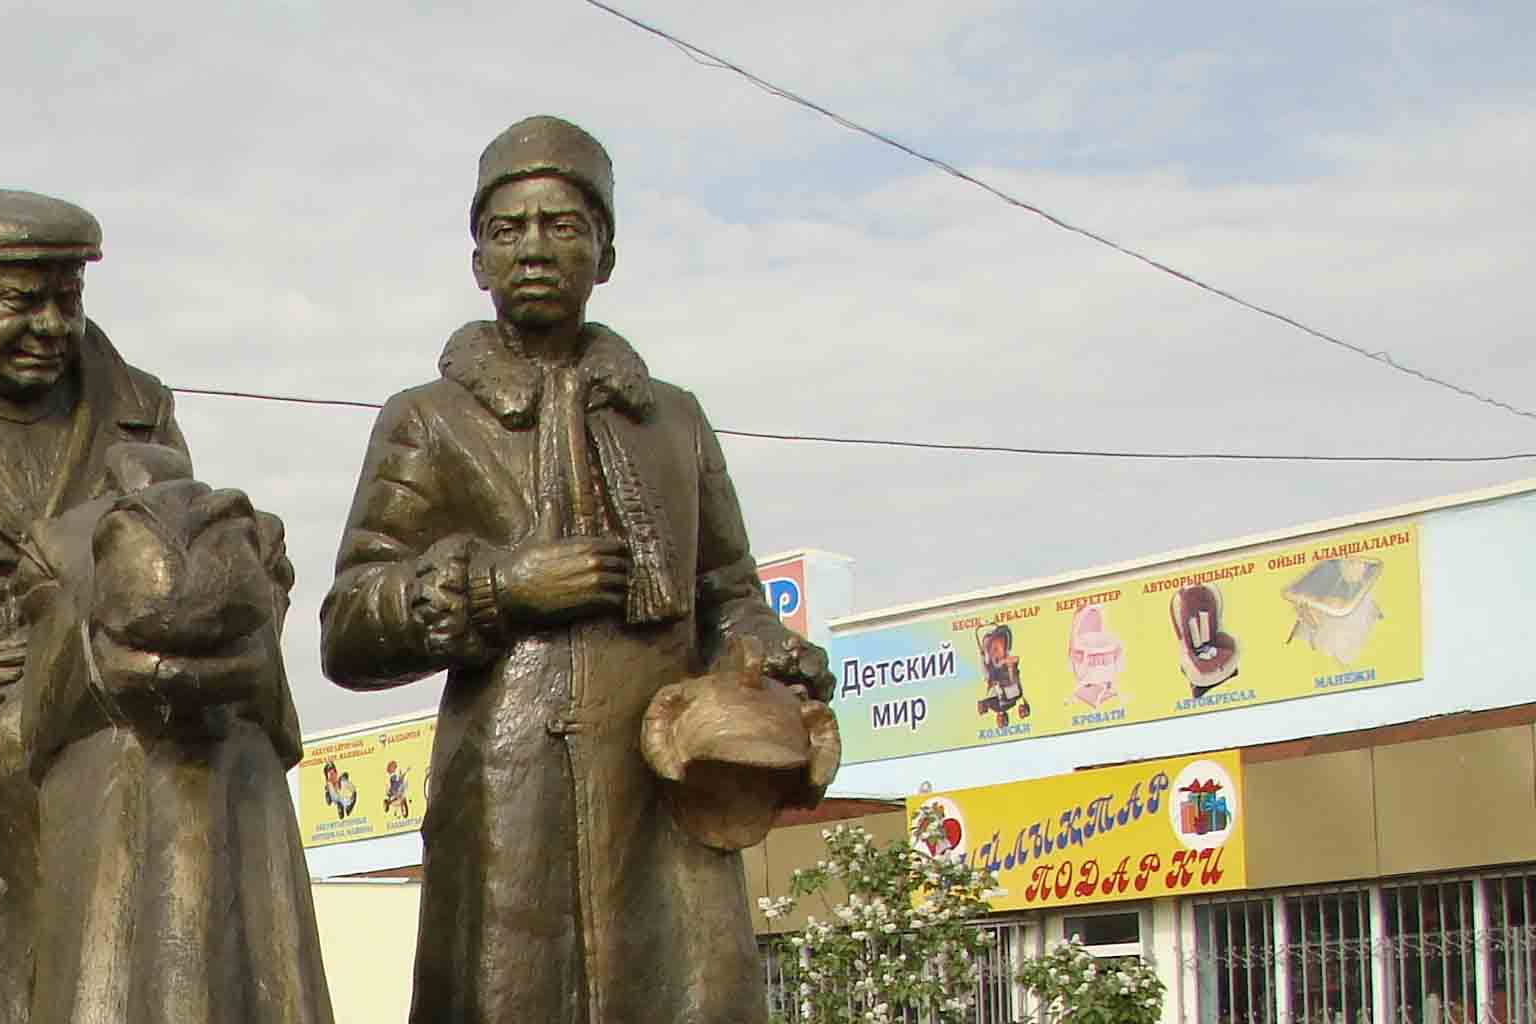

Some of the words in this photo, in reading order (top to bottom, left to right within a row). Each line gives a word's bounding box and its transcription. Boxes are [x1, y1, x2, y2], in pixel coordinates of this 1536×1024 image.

[841, 641, 955, 698] Детский
[872, 697, 926, 730] мир
[959, 771, 1169, 872] ЙЛЫҚТАР
[1025, 847, 1224, 903] ПОДАРКИ
